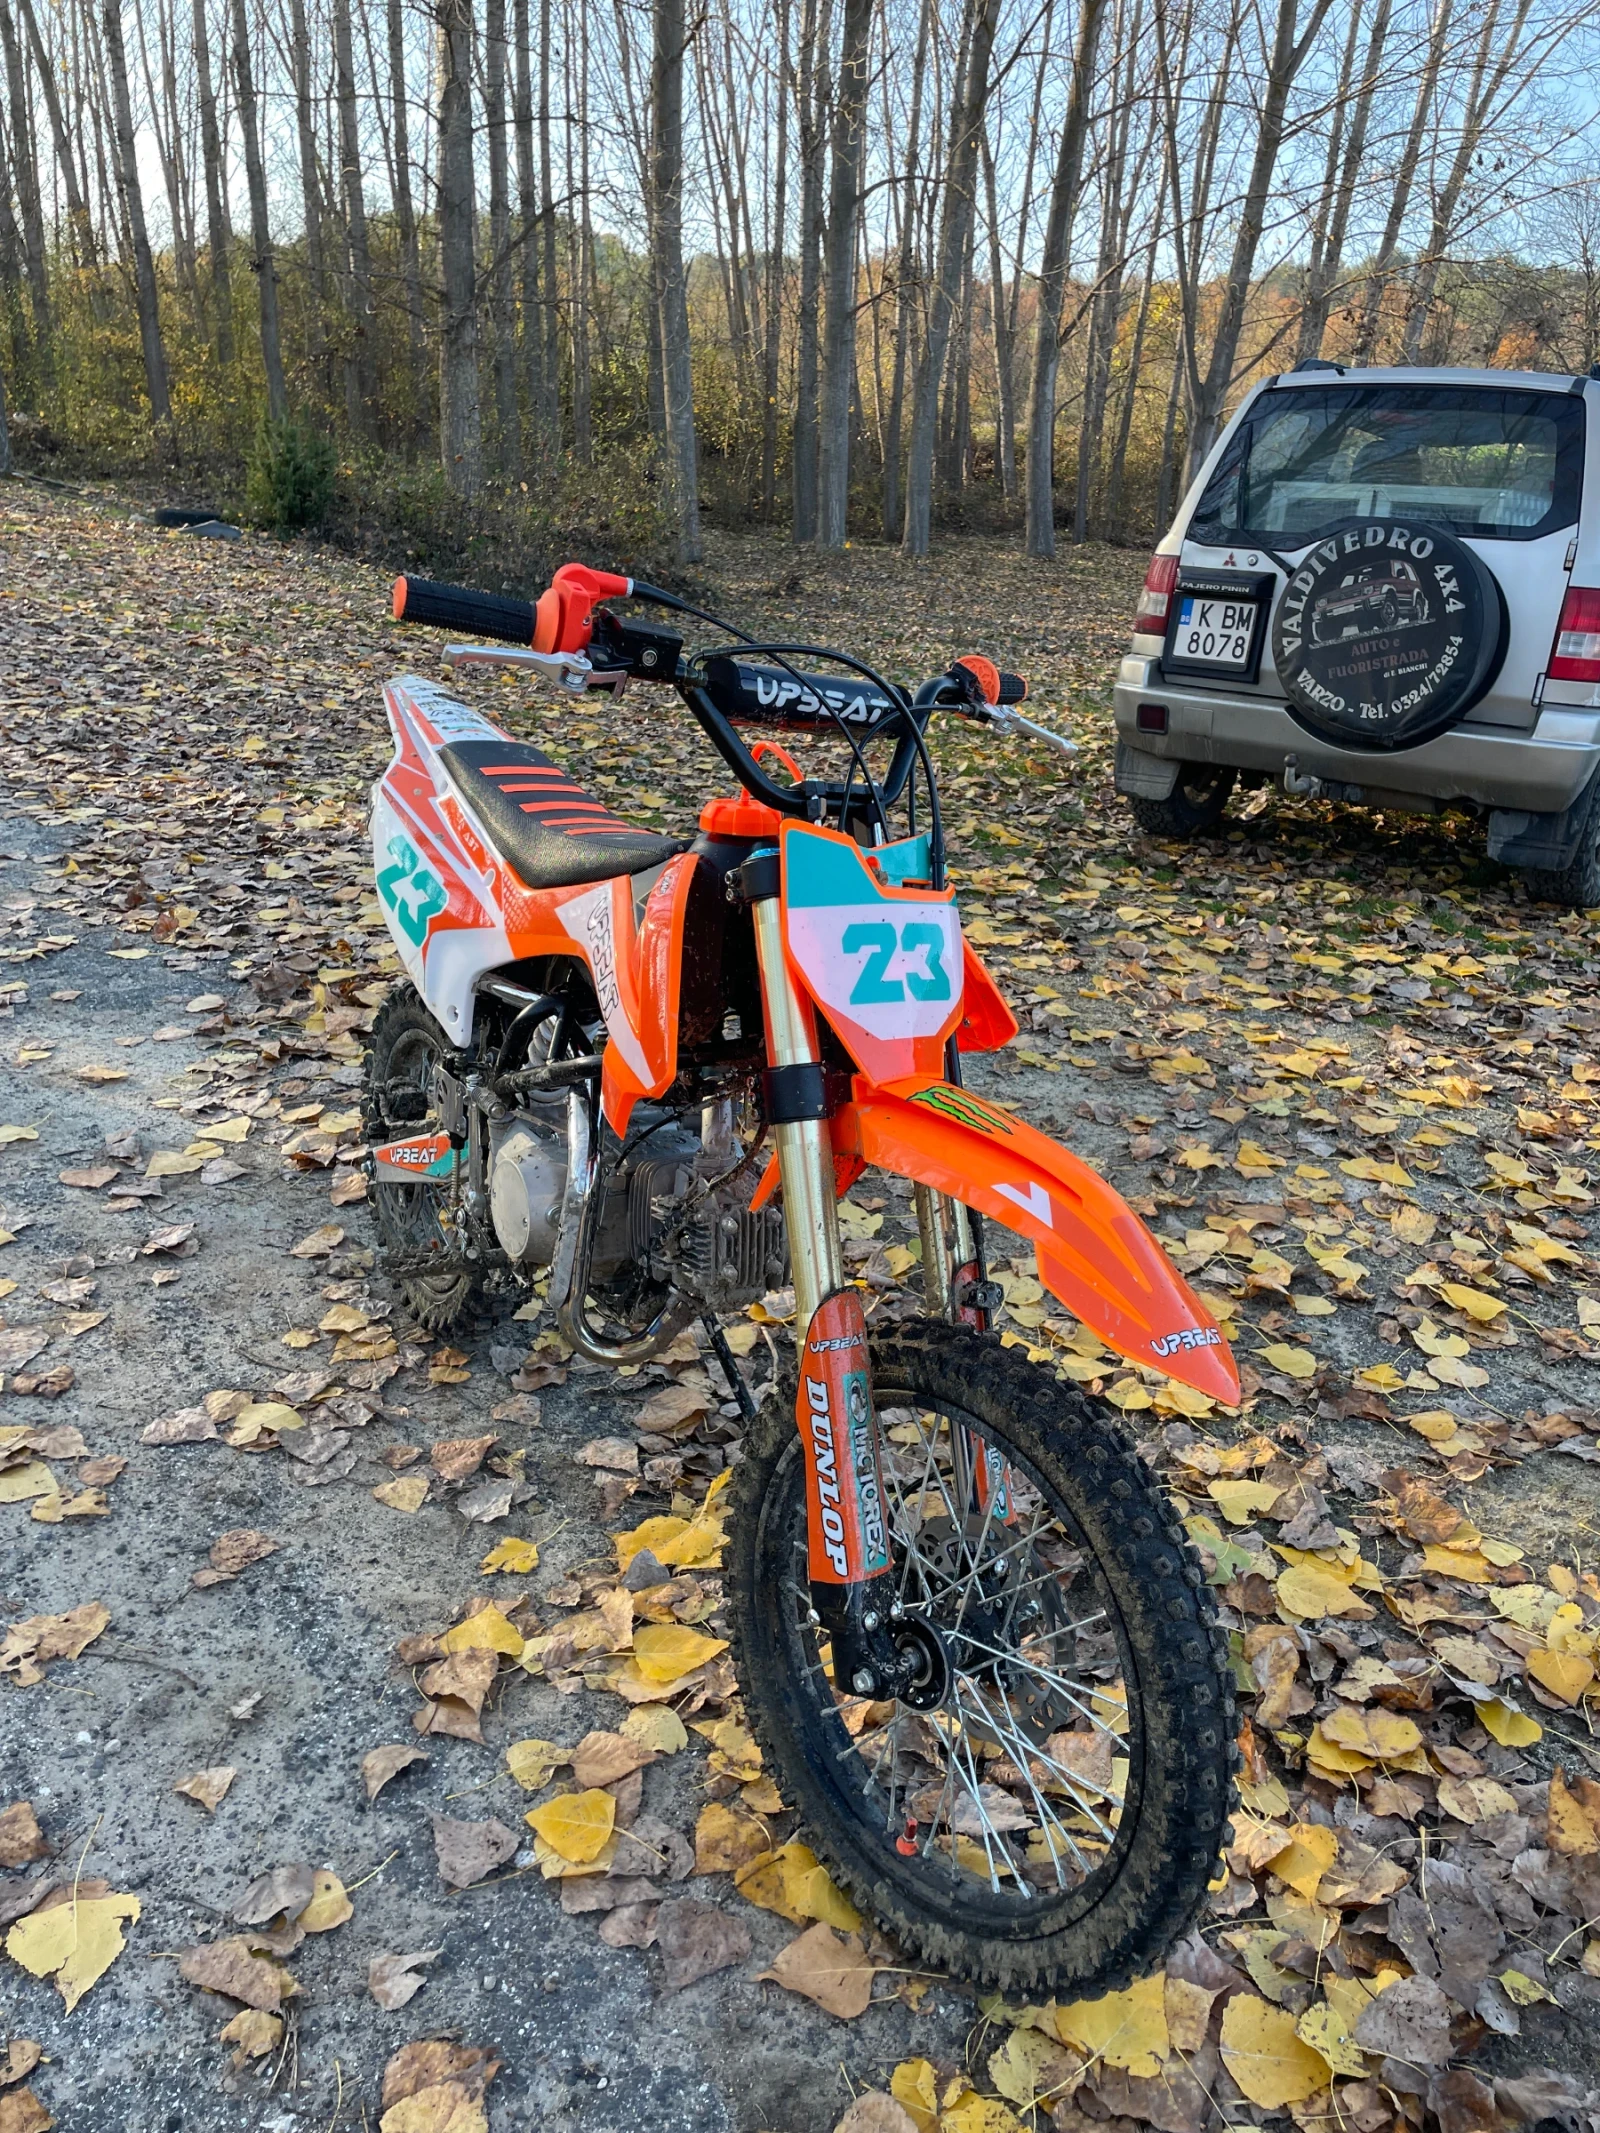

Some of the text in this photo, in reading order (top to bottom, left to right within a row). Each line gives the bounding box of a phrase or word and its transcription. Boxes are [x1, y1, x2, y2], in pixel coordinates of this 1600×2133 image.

[1181, 582, 1249, 593] PAJERO PININ
[1180, 614, 1190, 623] BG
[1198, 603, 1253, 631] K BM
[1187, 631, 1245, 659] 8078
[1351, 638, 1400, 656] AUTO e
[1296, 667, 1345, 711] VARZO
[1359, 702, 1389, 719] Tel.
[1391, 635, 1464, 713] 0324/72854
[1328, 648, 1429, 679] FUORISTRADA
[1398, 662, 1428, 675] BIANCHI
[757, 676, 889, 723] UPBEAT
[376, 834, 449, 948] 23
[841, 922, 951, 1005] 23
[389, 1147, 438, 1164] UPBEAT
[809, 1332, 865, 1354] UPBEAT
[1150, 1327, 1222, 1357] UPBEAT
[805, 1375, 849, 1578] DUNLOP
